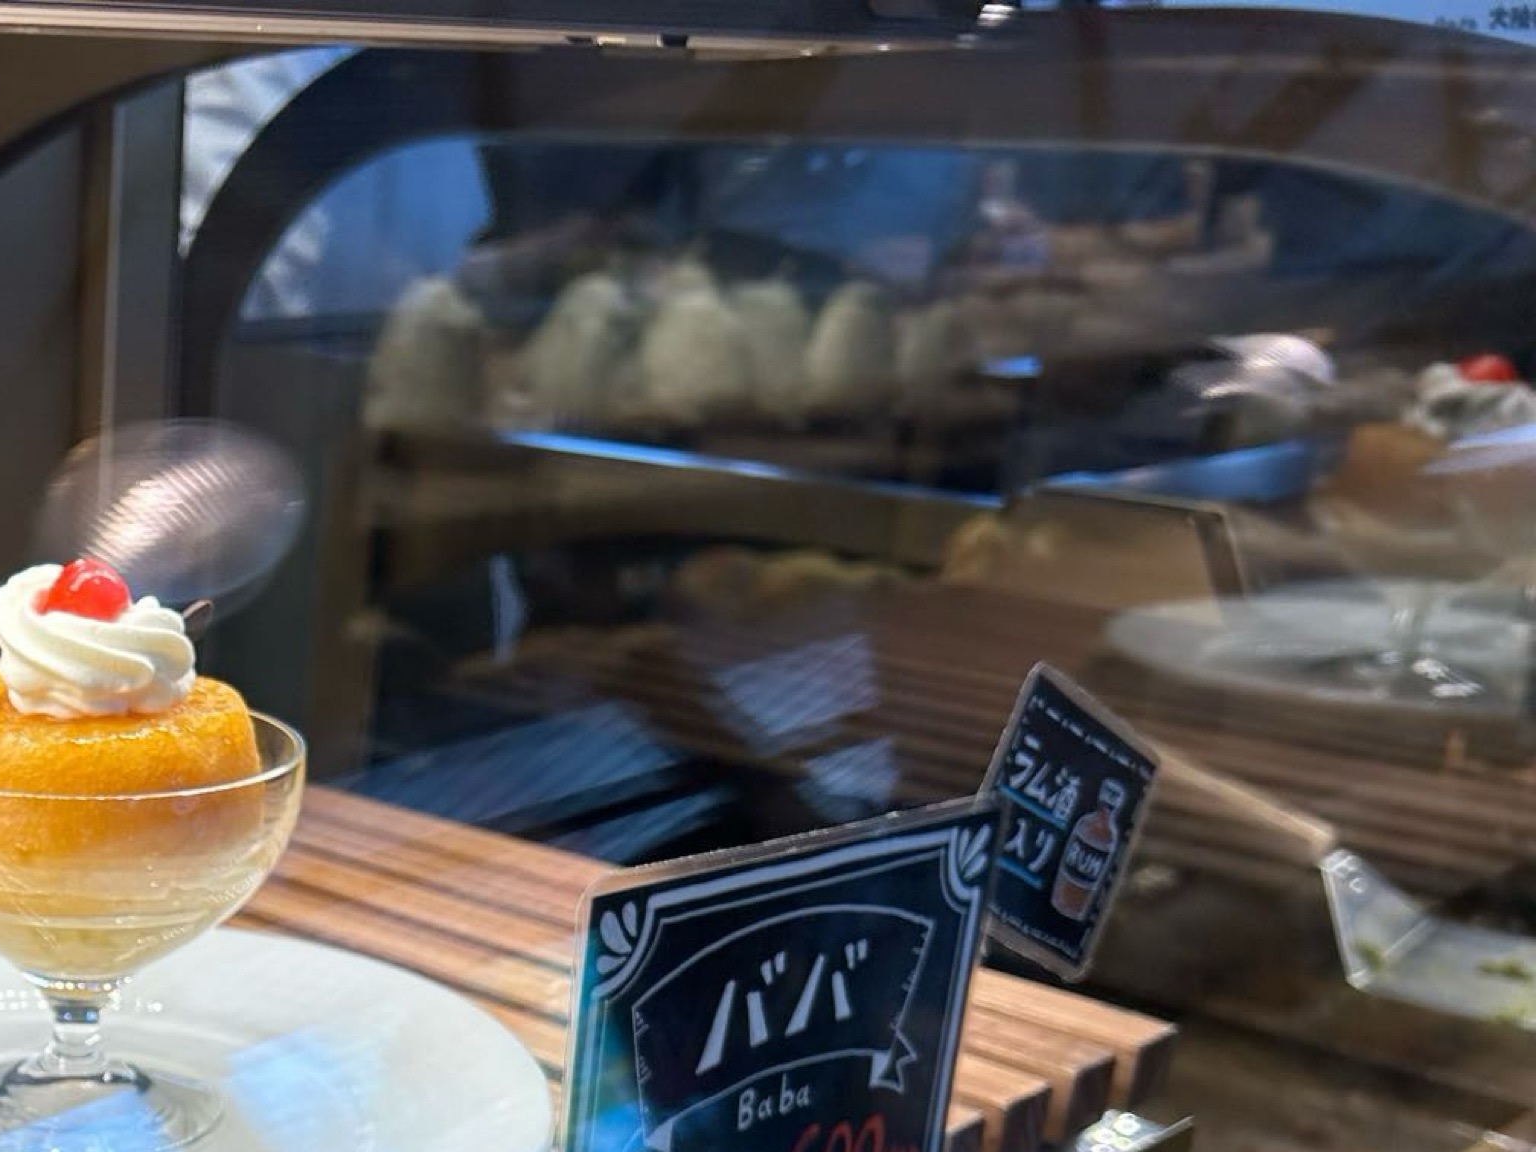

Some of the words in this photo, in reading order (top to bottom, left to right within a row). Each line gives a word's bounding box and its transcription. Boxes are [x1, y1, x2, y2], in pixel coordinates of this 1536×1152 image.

[1008, 734, 1082, 823] ラム酒
[1004, 817, 1057, 873] 入り
[1068, 842, 1103, 876] RUM
[695, 938, 869, 1077] ババ
[738, 1074, 812, 1131] Baba
